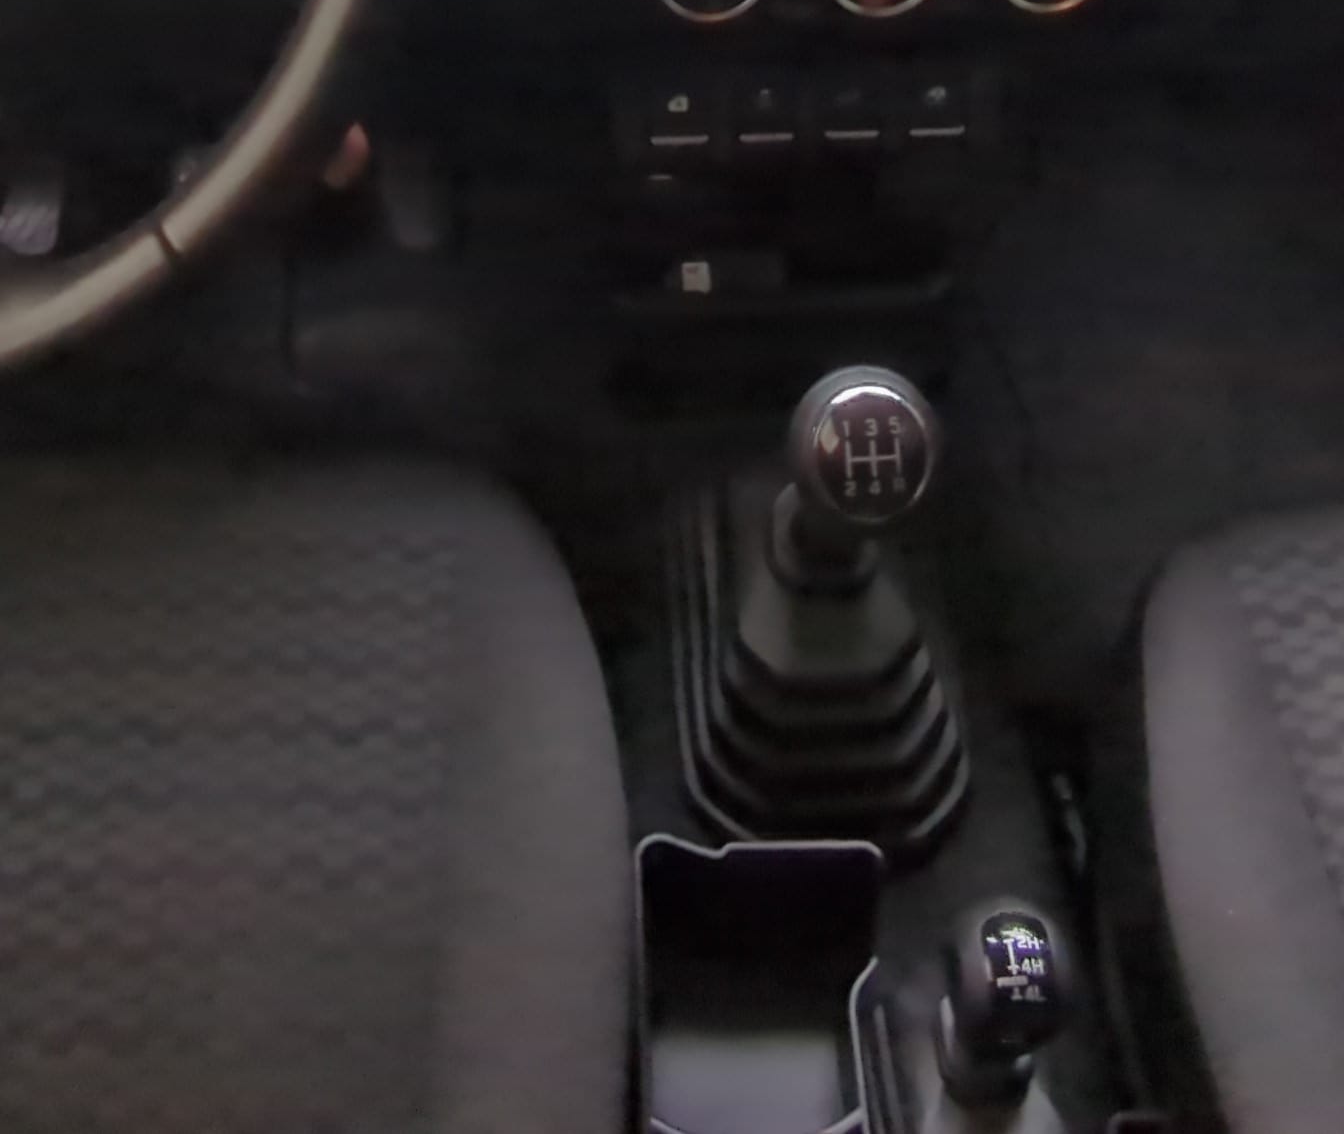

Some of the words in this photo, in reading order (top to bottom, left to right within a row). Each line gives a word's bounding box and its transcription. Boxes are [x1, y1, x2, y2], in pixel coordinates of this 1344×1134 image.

[842, 420, 850, 437] 1
[864, 418, 878, 436] 3
[888, 416, 901, 435] 5
[844, 480, 857, 497] 2
[1017, 934, 1040, 950] 2H
[1021, 957, 1045, 975] 4H
